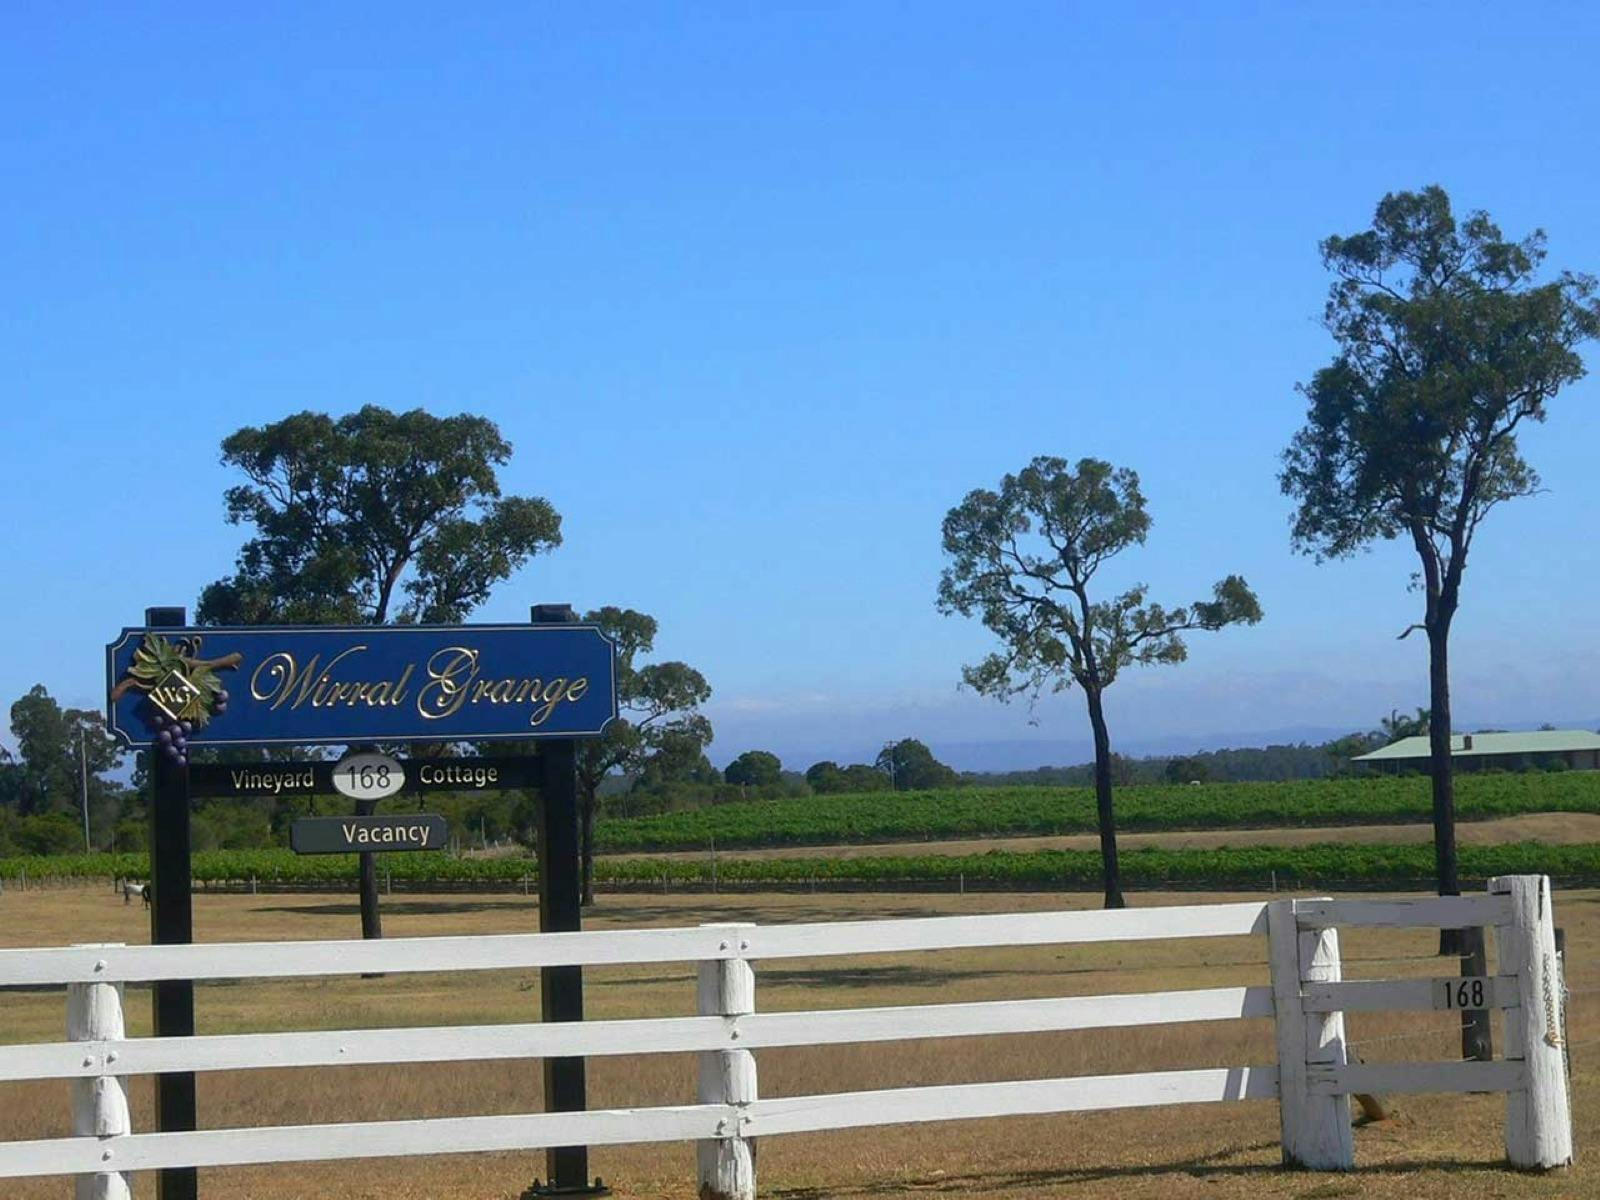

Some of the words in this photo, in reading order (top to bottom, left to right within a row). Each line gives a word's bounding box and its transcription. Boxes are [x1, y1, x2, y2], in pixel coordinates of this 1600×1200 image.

[250, 645, 416, 711] Wirral
[417, 645, 589, 727] Grange
[231, 767, 314, 794] Vineyard
[346, 764, 391, 790] 168
[420, 764, 498, 788] Cottage
[342, 823, 430, 846] Vacancy
[1445, 980, 1484, 1008] 168
